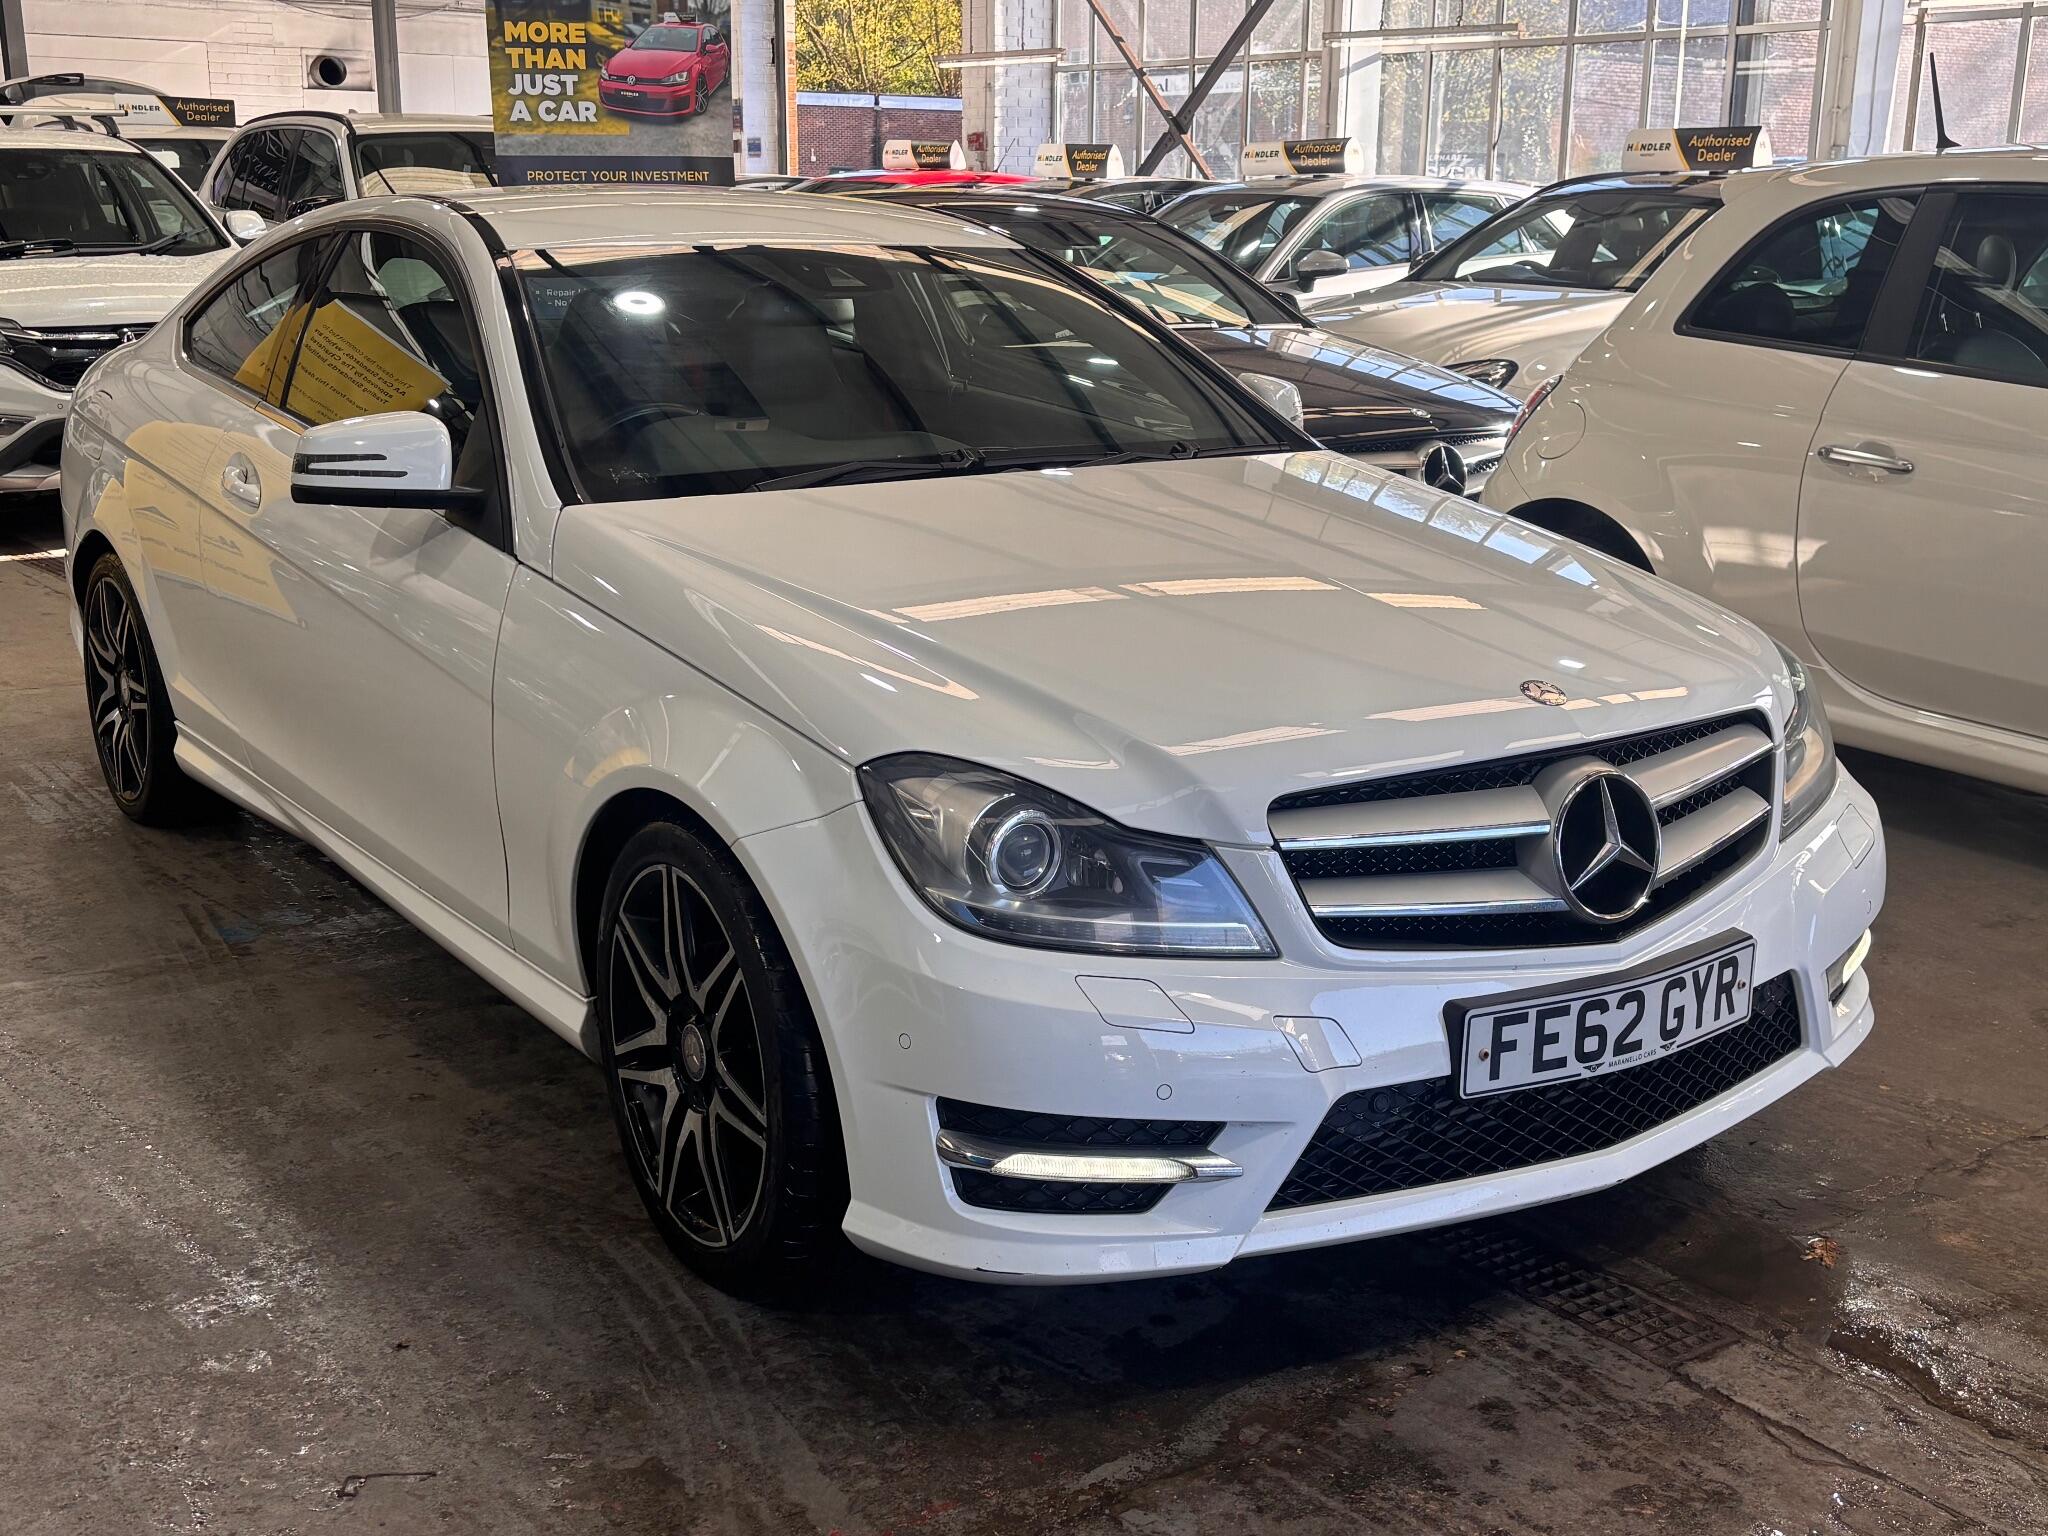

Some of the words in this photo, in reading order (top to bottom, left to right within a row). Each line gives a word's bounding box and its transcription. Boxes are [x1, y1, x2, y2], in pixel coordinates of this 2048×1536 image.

[504, 21, 586, 44] MORE
[505, 47, 586, 70] THAN
[508, 73, 578, 96] JUST
[176, 100, 230, 113] Authorised
[509, 100, 532, 122] A
[537, 100, 598, 123] CAR
[187, 112, 220, 122] Dealer
[1688, 132, 1752, 147] Authorised
[917, 144, 949, 154] Authorised
[1293, 142, 1343, 153] Authorised
[921, 153, 943, 164] Dealer
[1071, 149, 1108, 160] Authorised
[1697, 149, 1736, 162] Dealer
[1075, 160, 1099, 172] Dealer
[1300, 155, 1331, 167] Dealer
[527, 170, 588, 182] PROTECT
[592, 171, 627, 182] YOUR
[631, 171, 710, 182] INVESTMENT
[546, 288, 576, 297] Repair
[554, 299, 568, 307] No
[1489, 990, 1646, 1081] FE62
[1659, 955, 1739, 1042] GYR
[1608, 1053, 1643, 1068] MARANELLO
[1643, 1049, 1657, 1059] CARS
